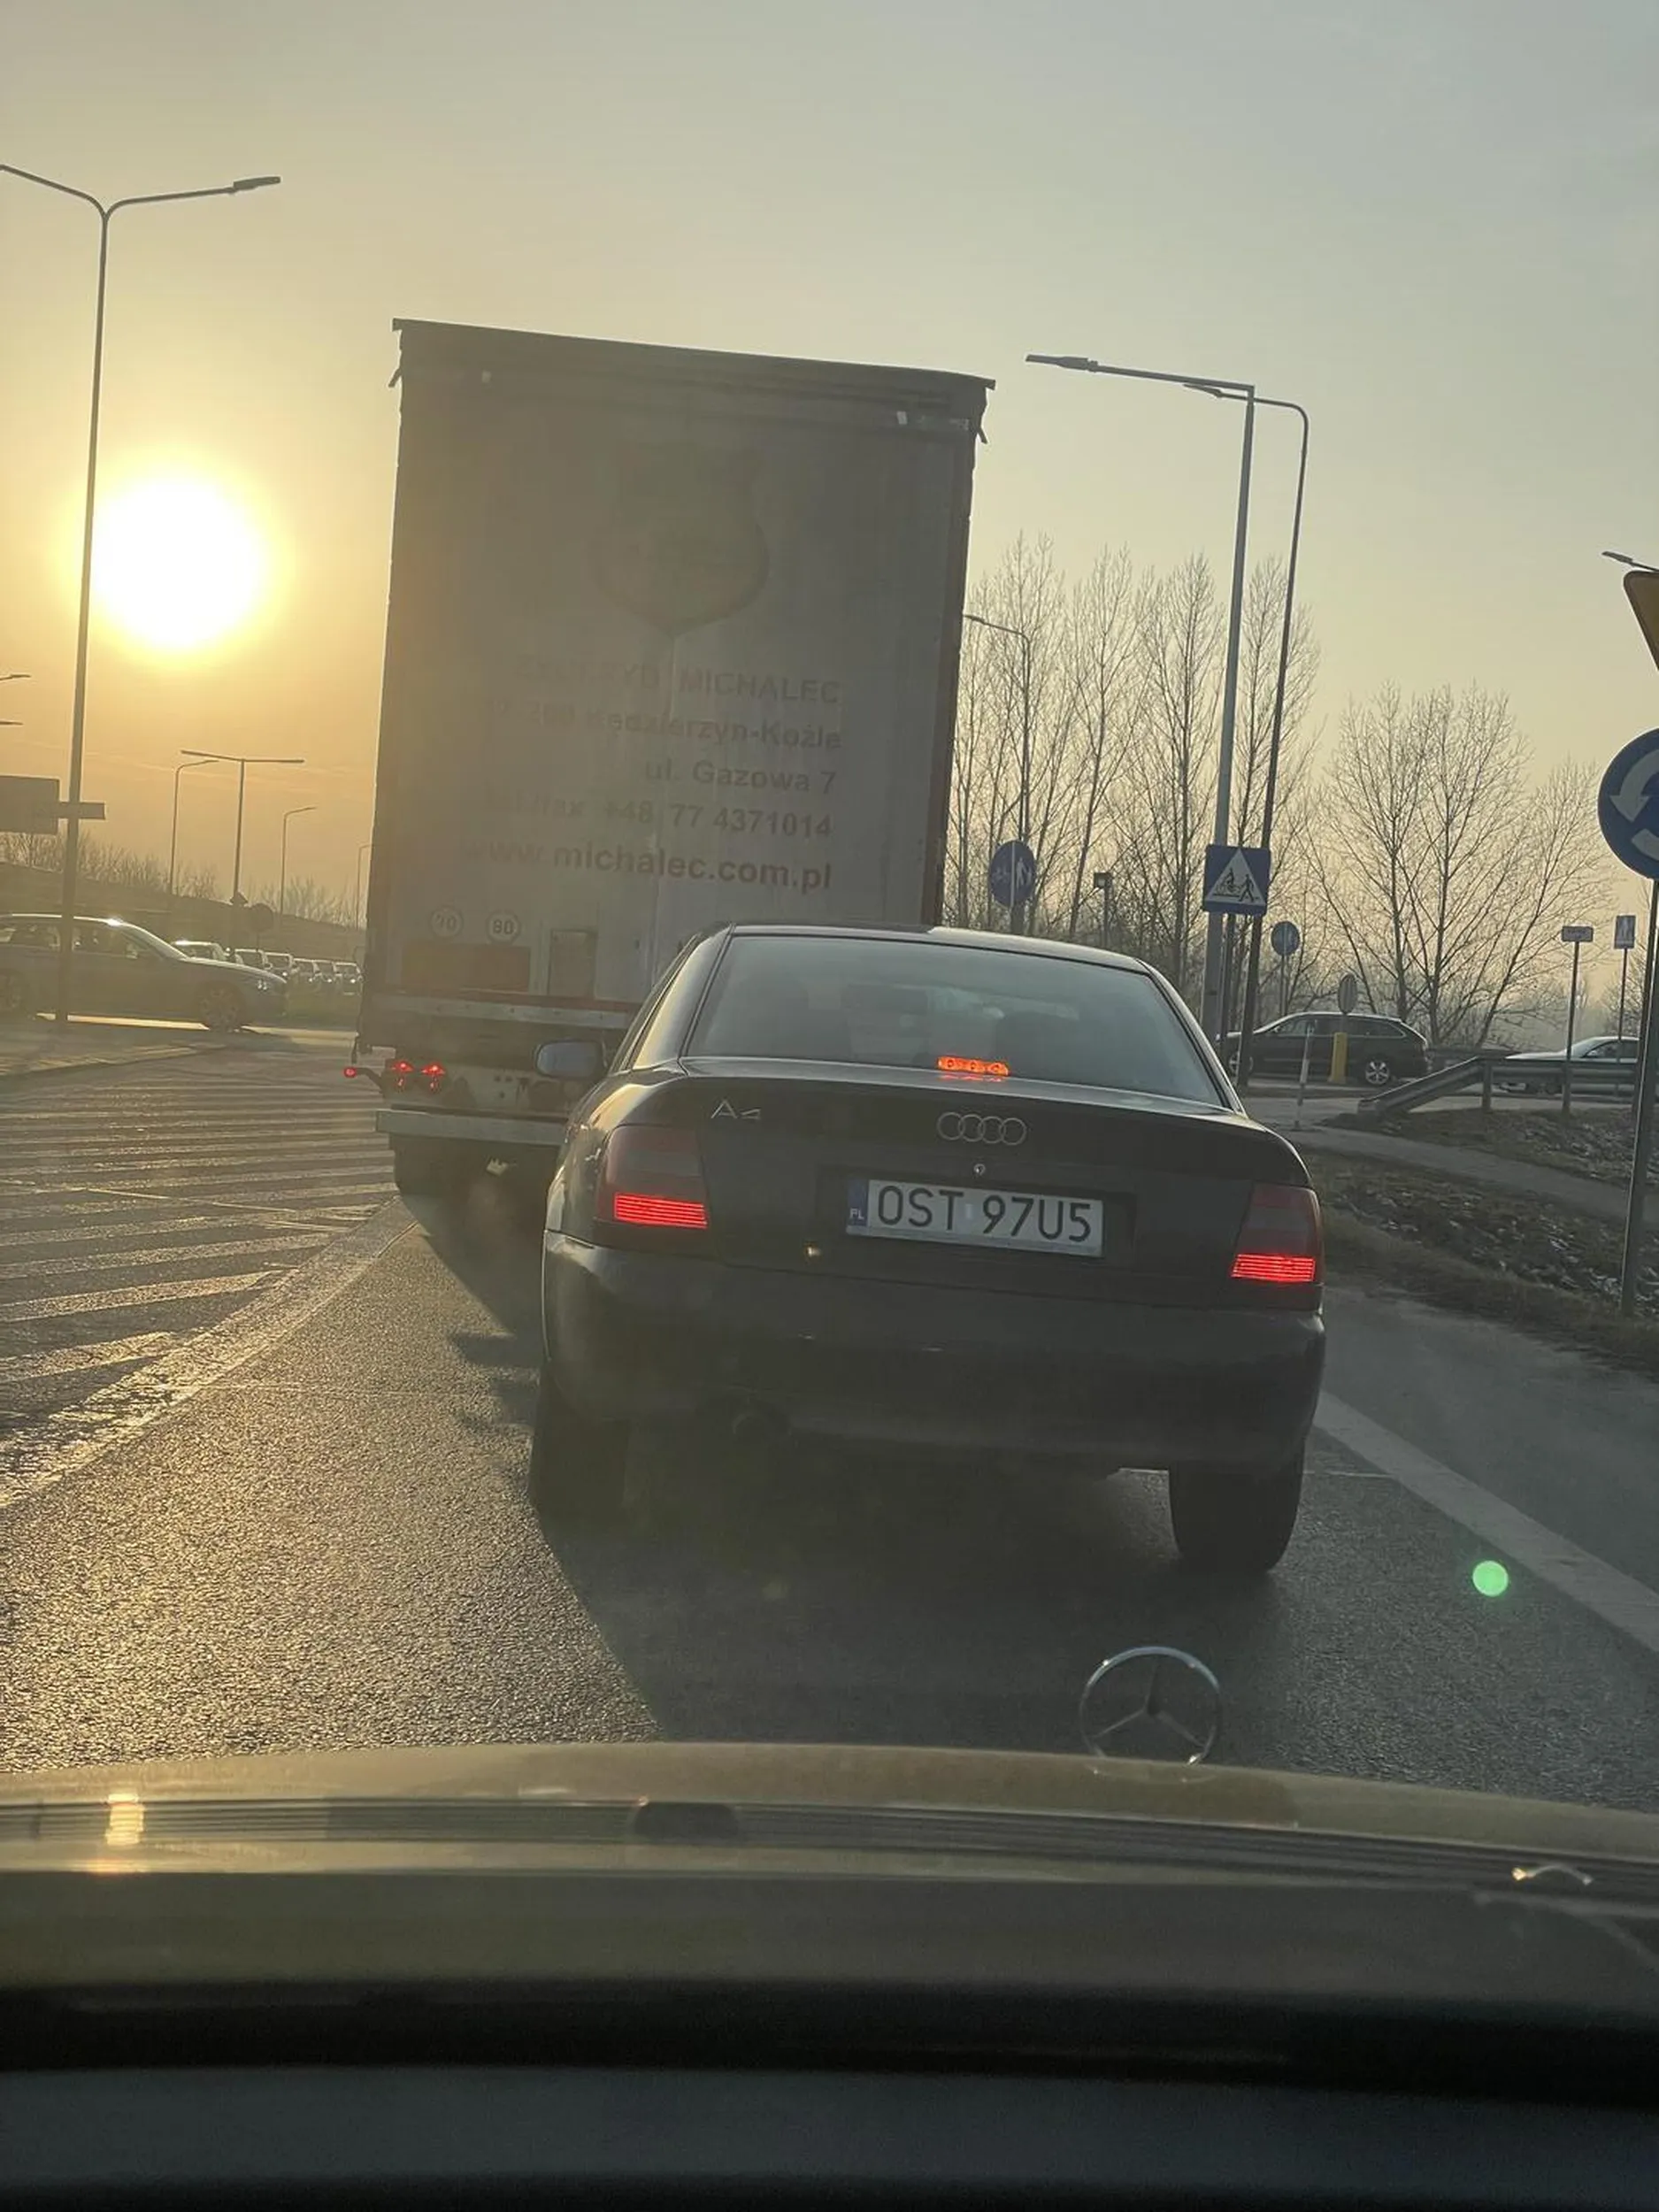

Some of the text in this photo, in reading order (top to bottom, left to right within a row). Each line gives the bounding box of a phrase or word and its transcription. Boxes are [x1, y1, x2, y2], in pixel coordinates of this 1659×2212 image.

[680, 665, 840, 704] MICHALEC
[646, 757, 837, 795] ul. Gazowa 7
[604, 797, 654, 825] +48
[669, 803, 704, 828] 77
[712, 806, 833, 838] 4371014
[878, 1186, 1092, 1242] OST 97U5
